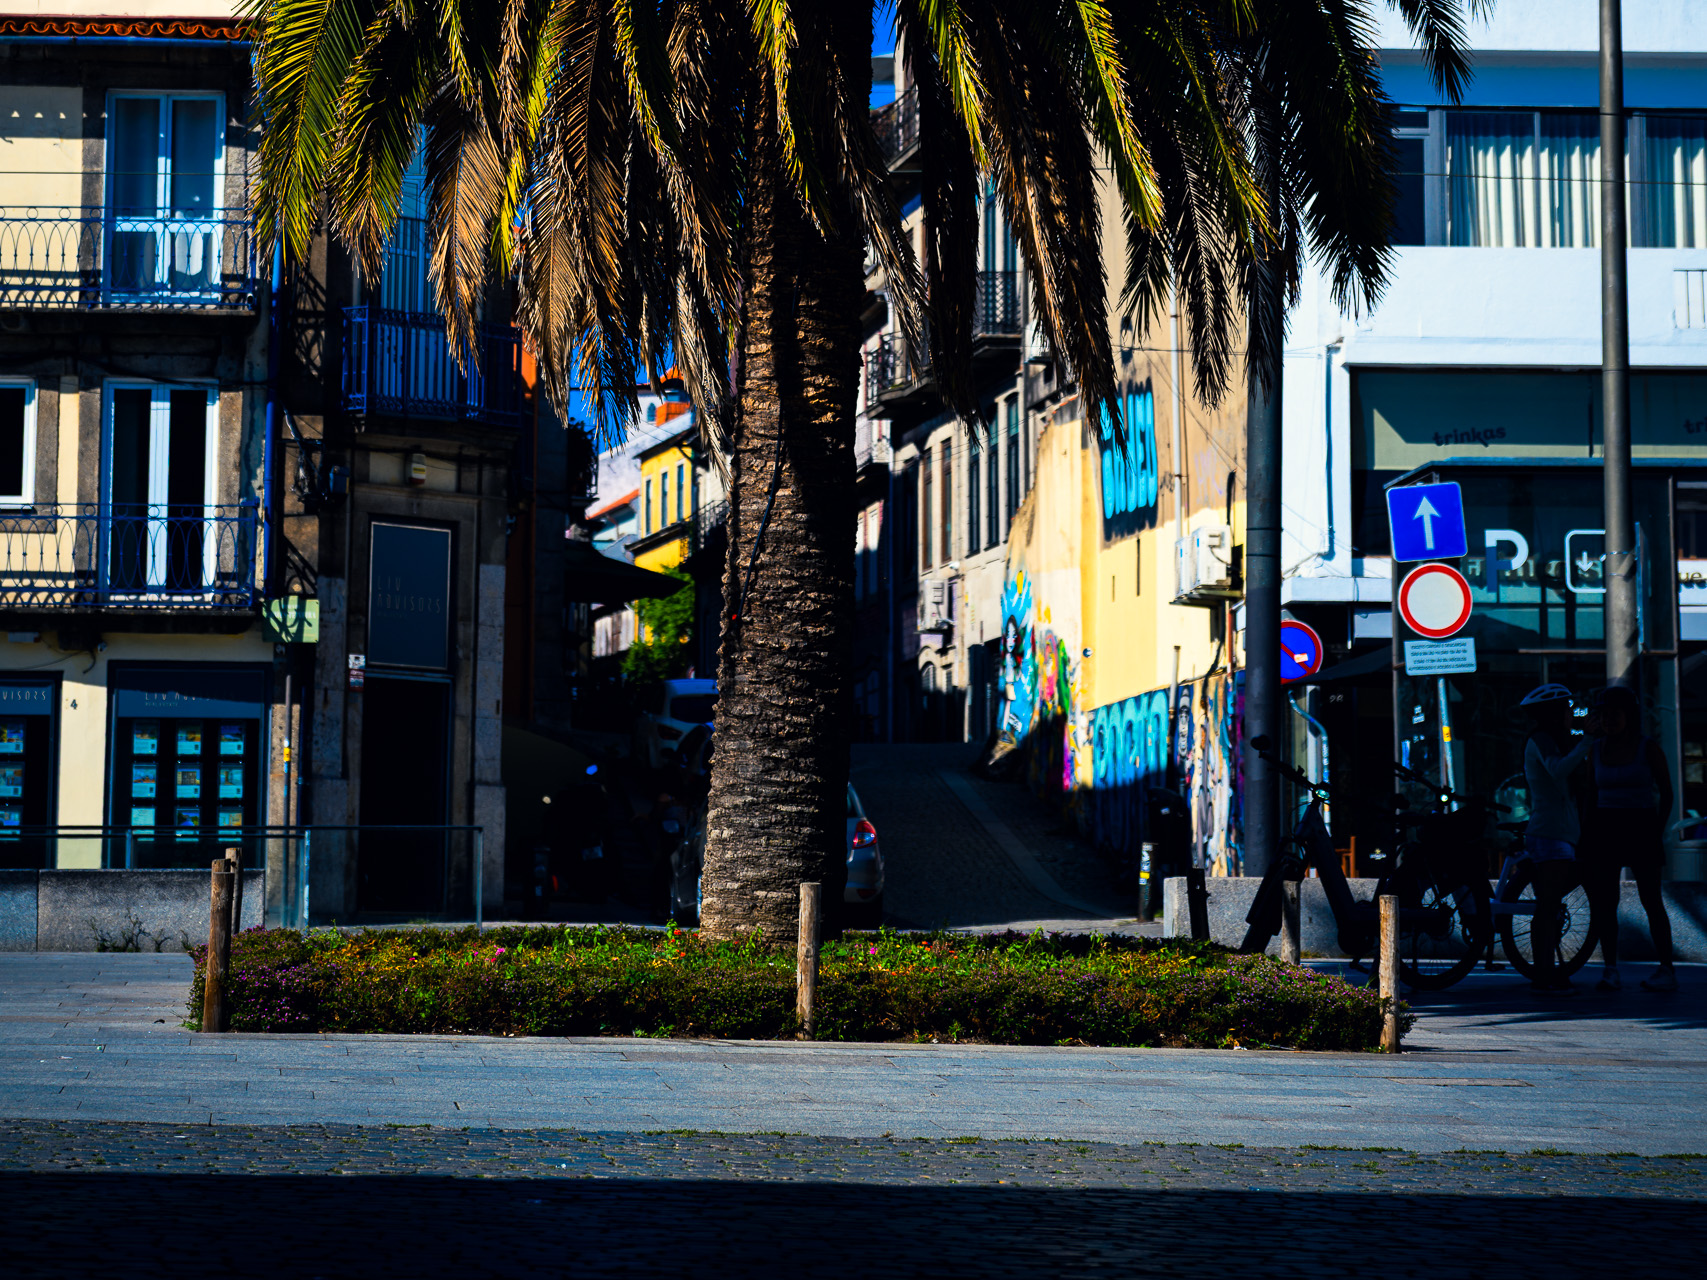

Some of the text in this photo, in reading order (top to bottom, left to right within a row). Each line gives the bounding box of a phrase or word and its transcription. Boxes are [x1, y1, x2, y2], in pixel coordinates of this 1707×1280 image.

[1432, 426, 1507, 448] trinkas
[1485, 528, 1530, 593] P
[70, 698, 78, 710] 4
